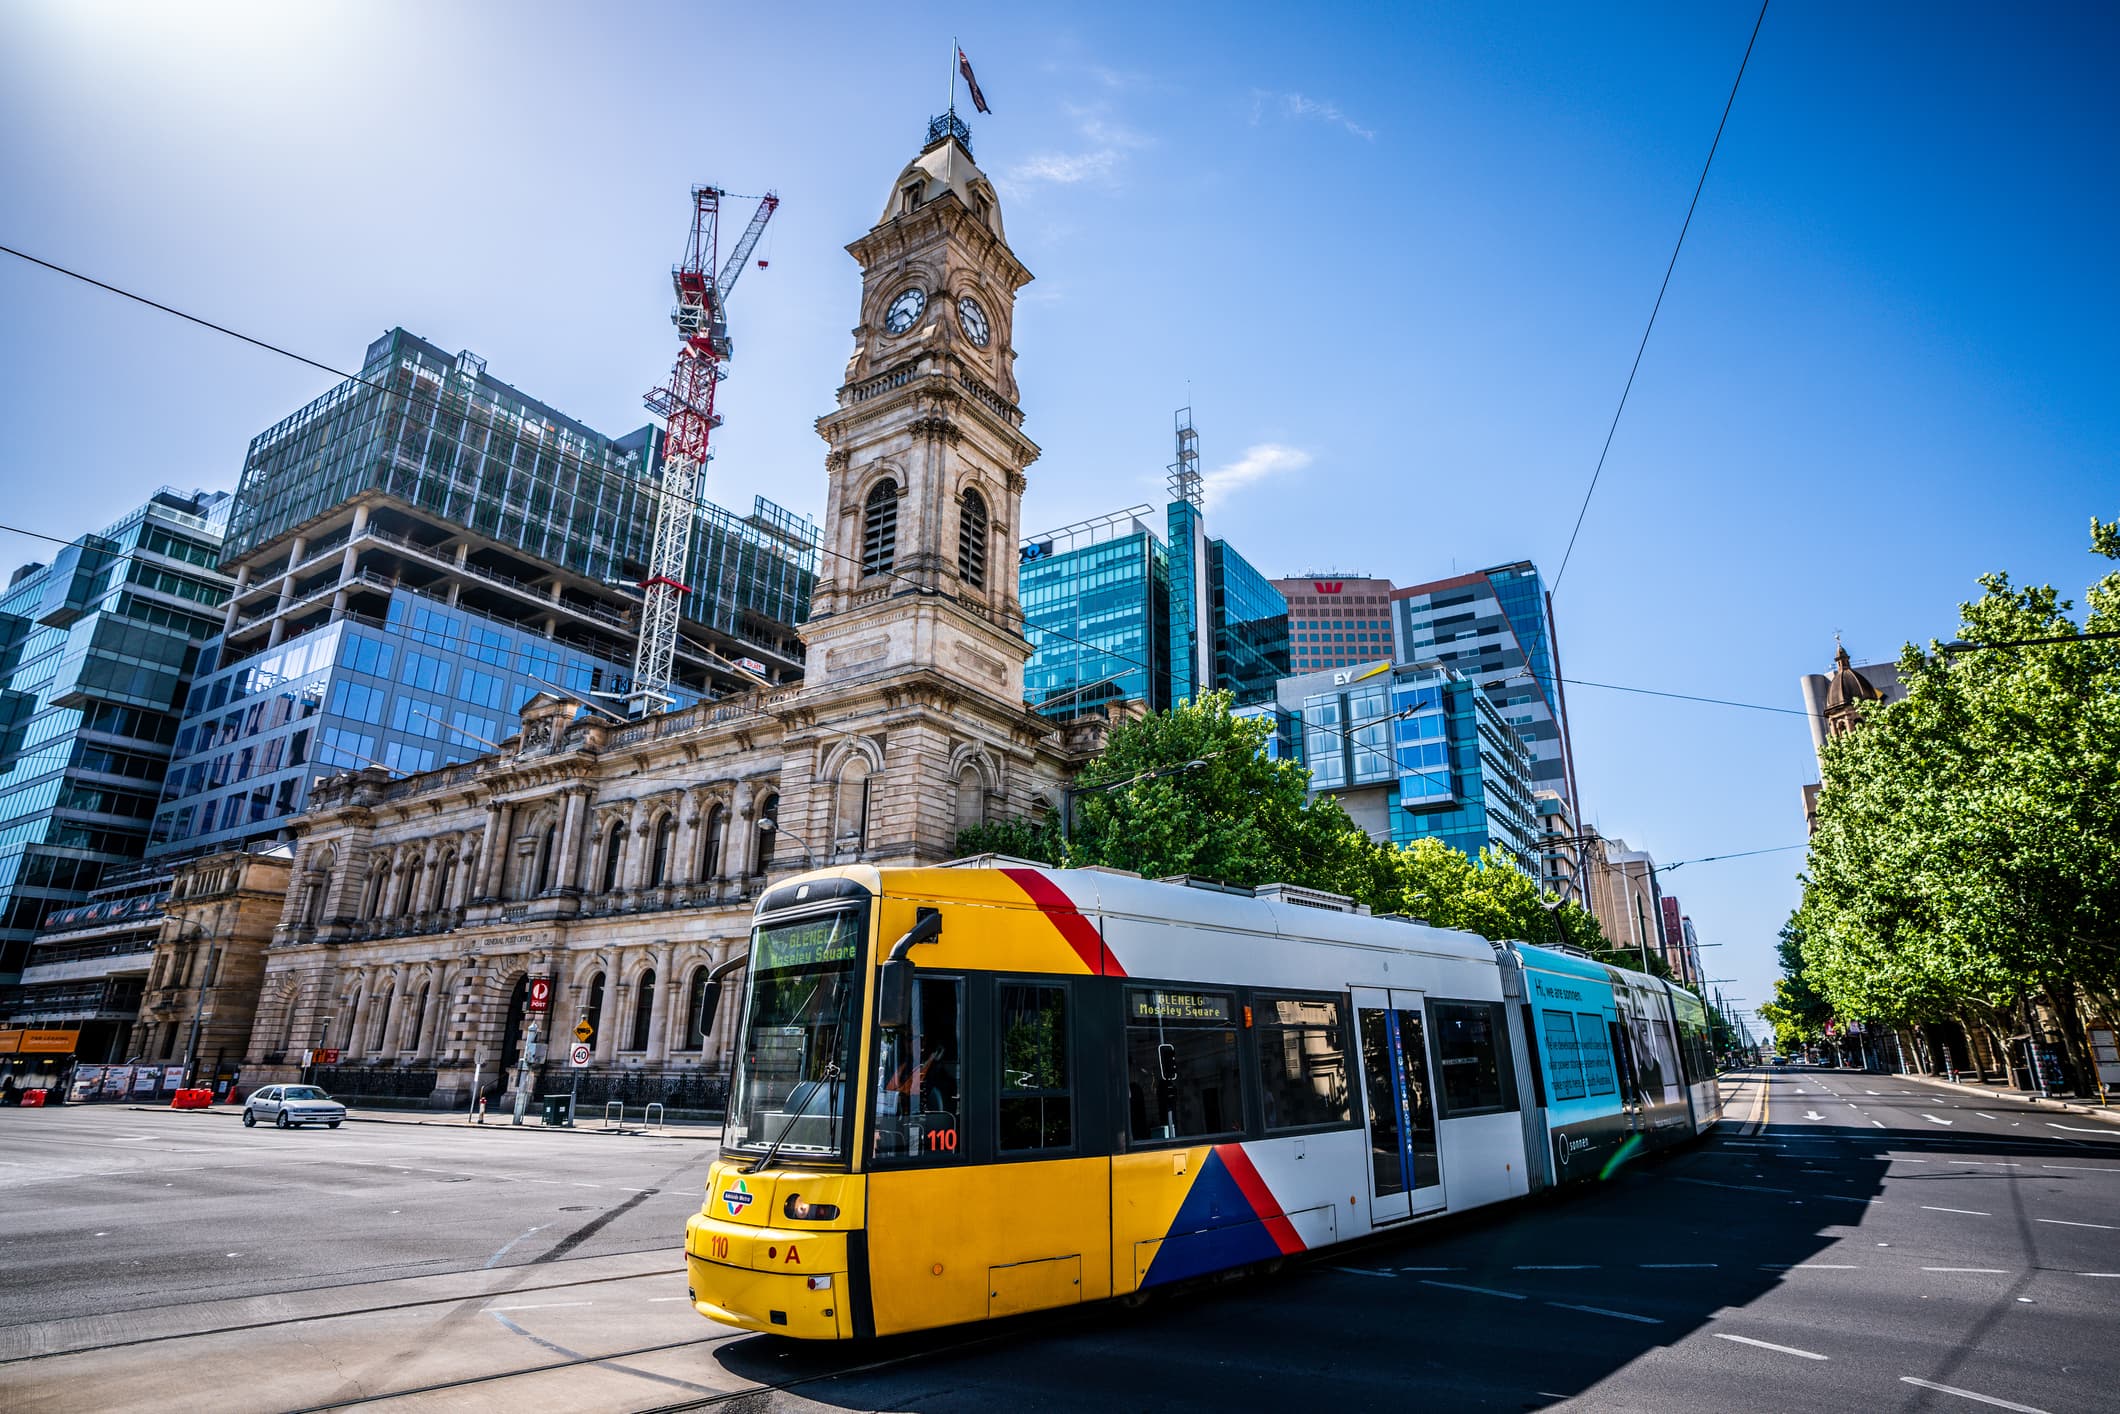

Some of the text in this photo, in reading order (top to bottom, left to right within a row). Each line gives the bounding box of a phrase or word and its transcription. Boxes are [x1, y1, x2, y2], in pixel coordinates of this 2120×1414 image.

[1334, 671, 1352, 686] EY
[484, 937, 504, 945] GENERAL
[505, 935, 516, 944] POST
[789, 928, 839, 948] GLENELG
[815, 945, 857, 962] Square
[1158, 994, 1203, 1006] GLENELG
[1139, 1003, 1220, 1017] Moseley Square
[576, 1051, 586, 1060] 40
[928, 1129, 957, 1151] 110
[1570, 1137, 1588, 1151] sonnen
[712, 1235, 728, 1259] 110
[784, 1245, 801, 1264] A
